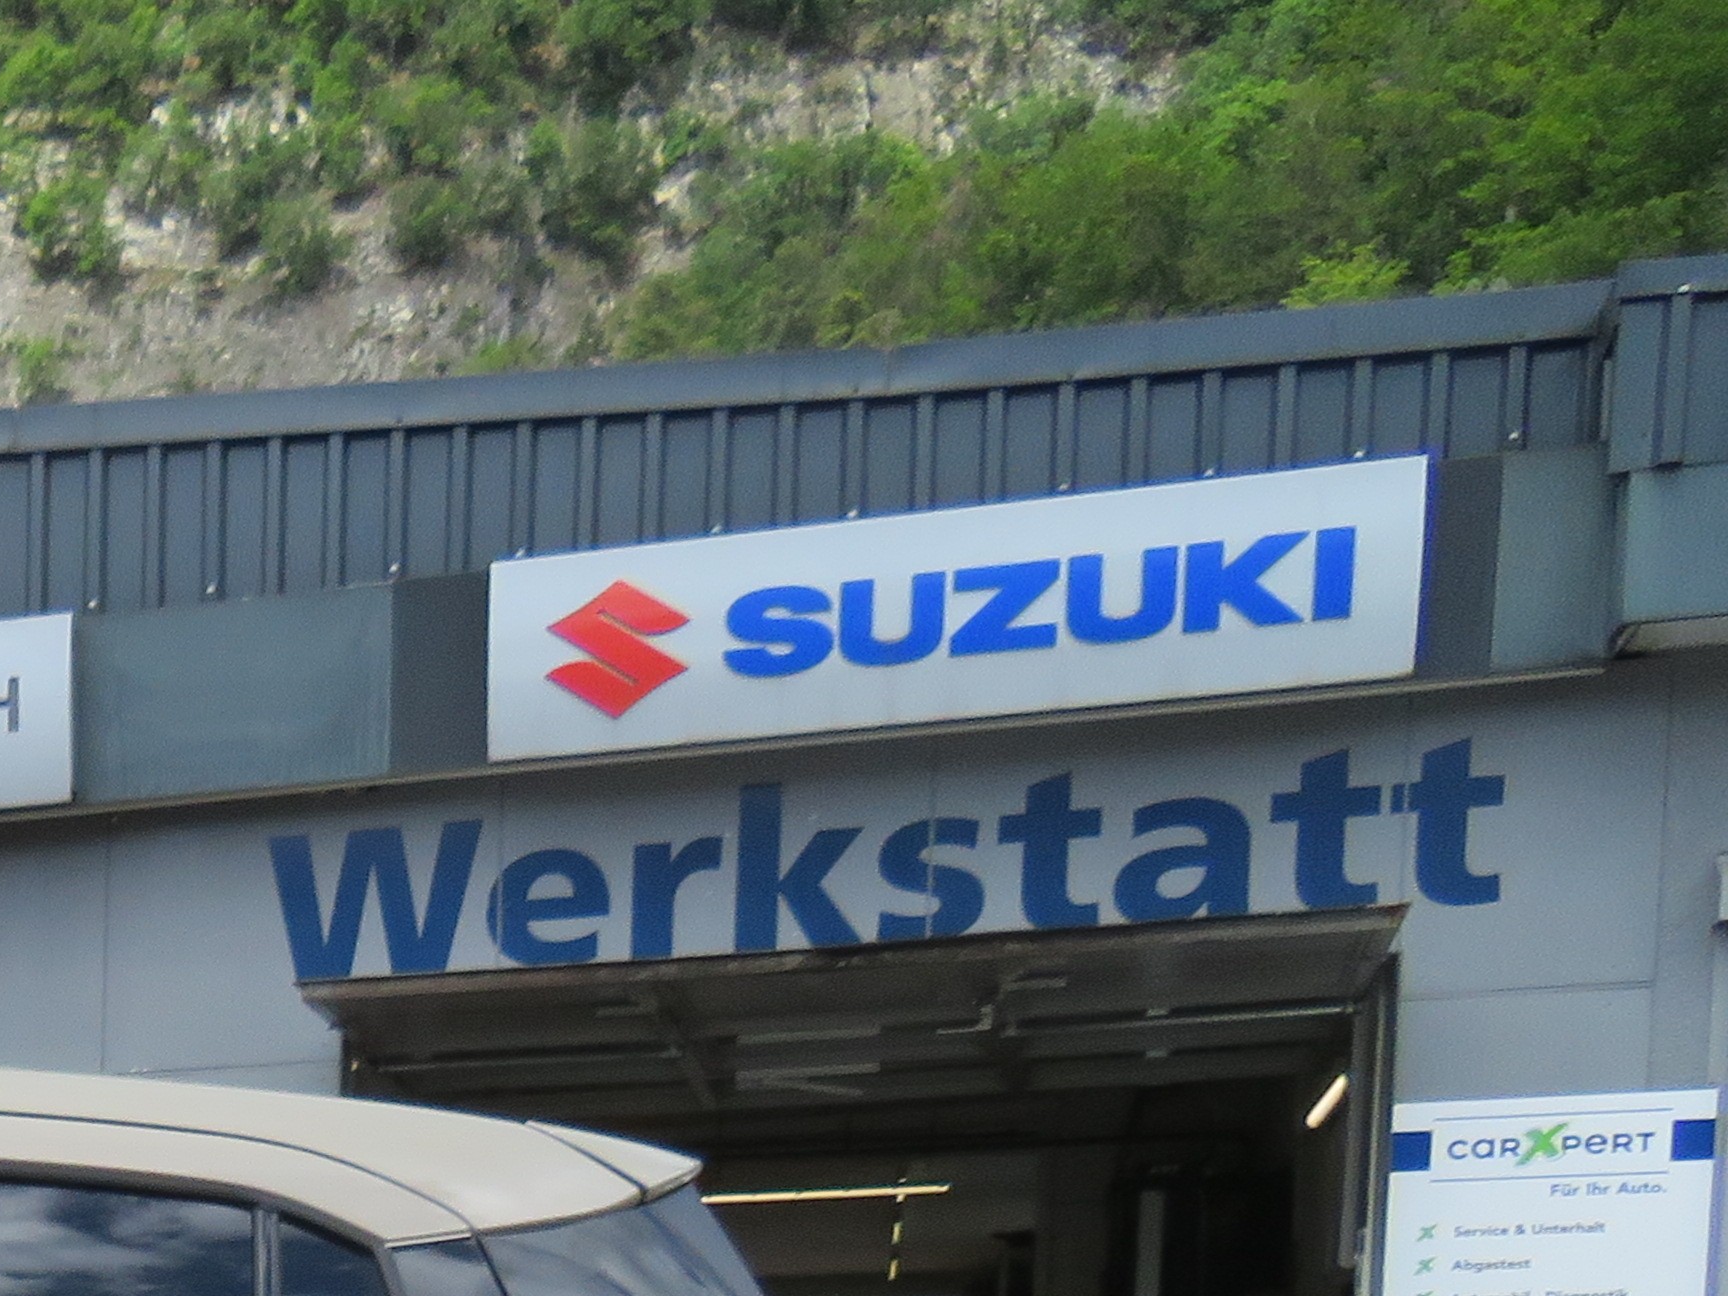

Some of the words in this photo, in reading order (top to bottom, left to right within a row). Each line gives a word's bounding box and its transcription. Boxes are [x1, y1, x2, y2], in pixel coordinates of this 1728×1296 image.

[722, 526, 1357, 680] SUZUKI
[267, 738, 1506, 980] Werkstatt
[1550, 1182, 1580, 1198] Für
[1586, 1180, 1610, 1197] Ihr
[1617, 1179, 1667, 1195] Auto.
[1454, 1225, 1509, 1238] Service
[1514, 1224, 1525, 1235] &
[1532, 1221, 1606, 1235] Unterhalt
[1451, 1258, 1531, 1274] Abgastest
